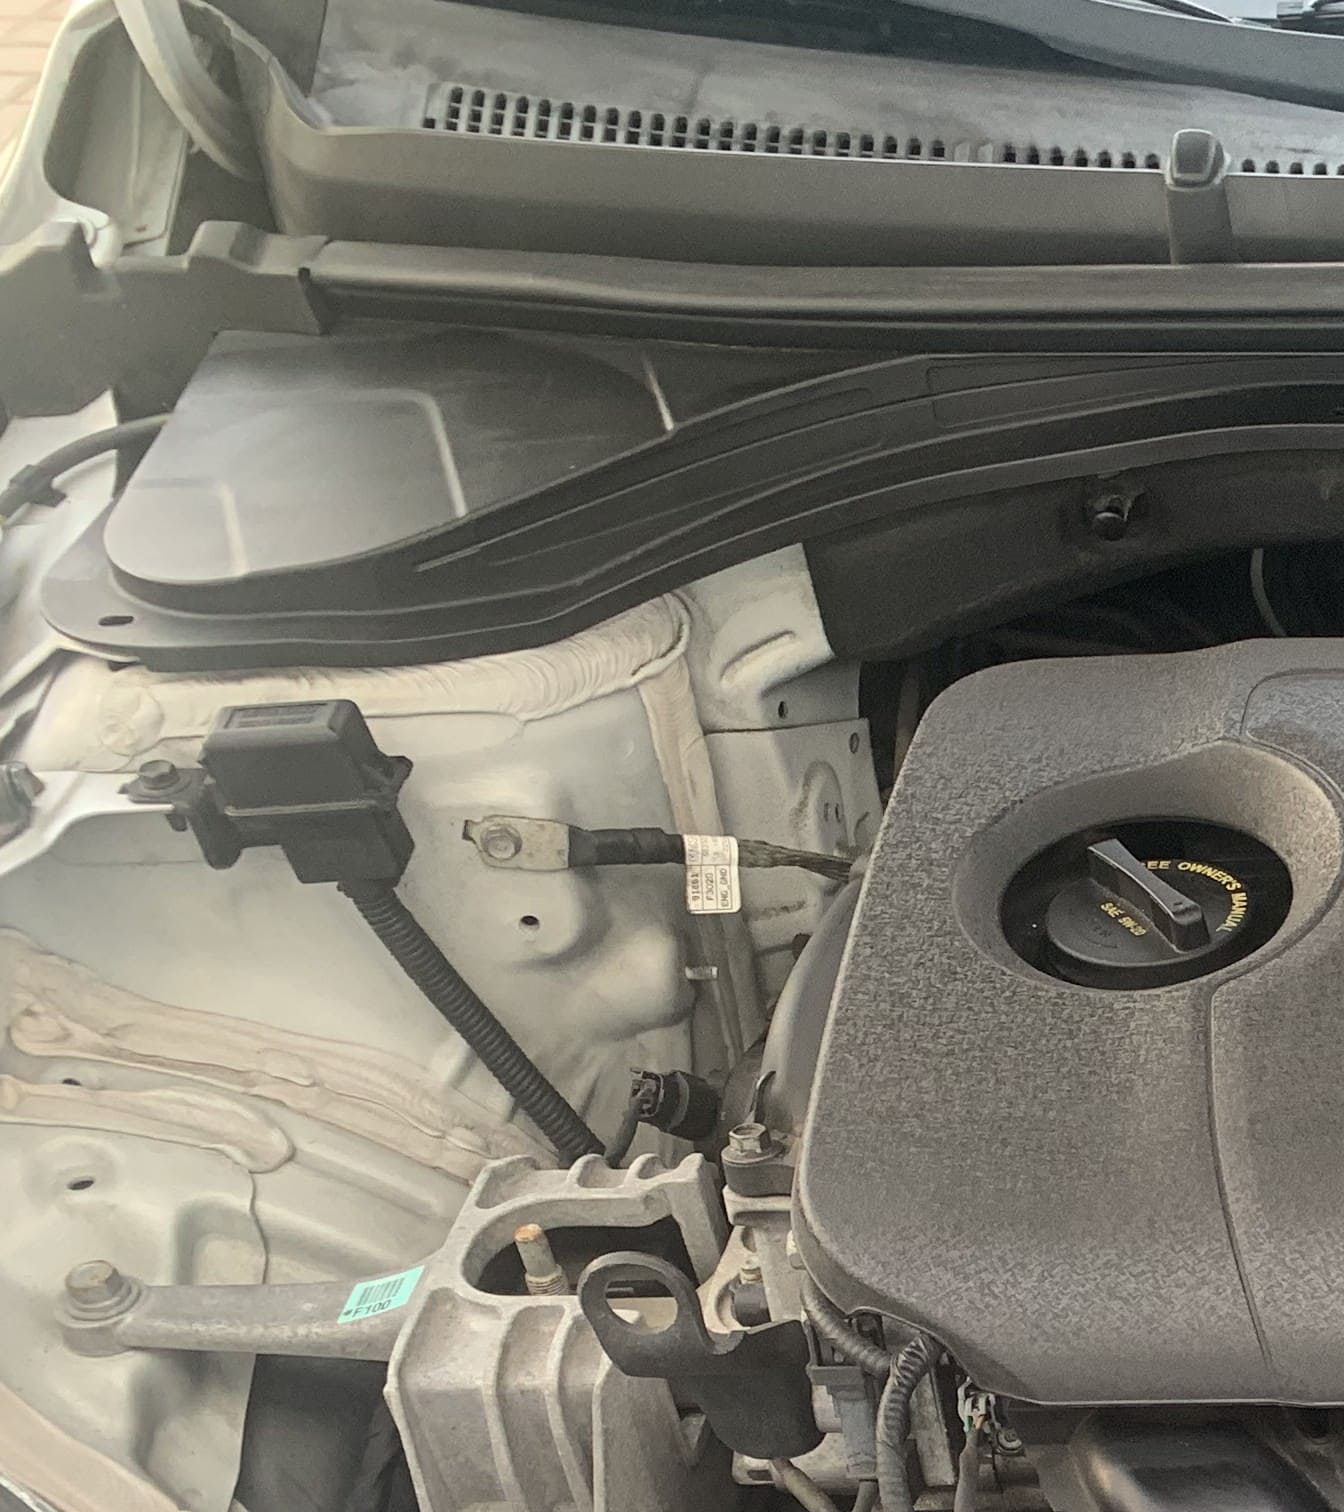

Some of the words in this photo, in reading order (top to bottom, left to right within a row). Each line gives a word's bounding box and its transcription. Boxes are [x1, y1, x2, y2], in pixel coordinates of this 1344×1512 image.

[1100, 902, 1125, 919] SAE
[1142, 861, 1172, 870] EE
[1177, 862, 1242, 891] OWNER'S
[1216, 892, 1248, 932] MANUAL
